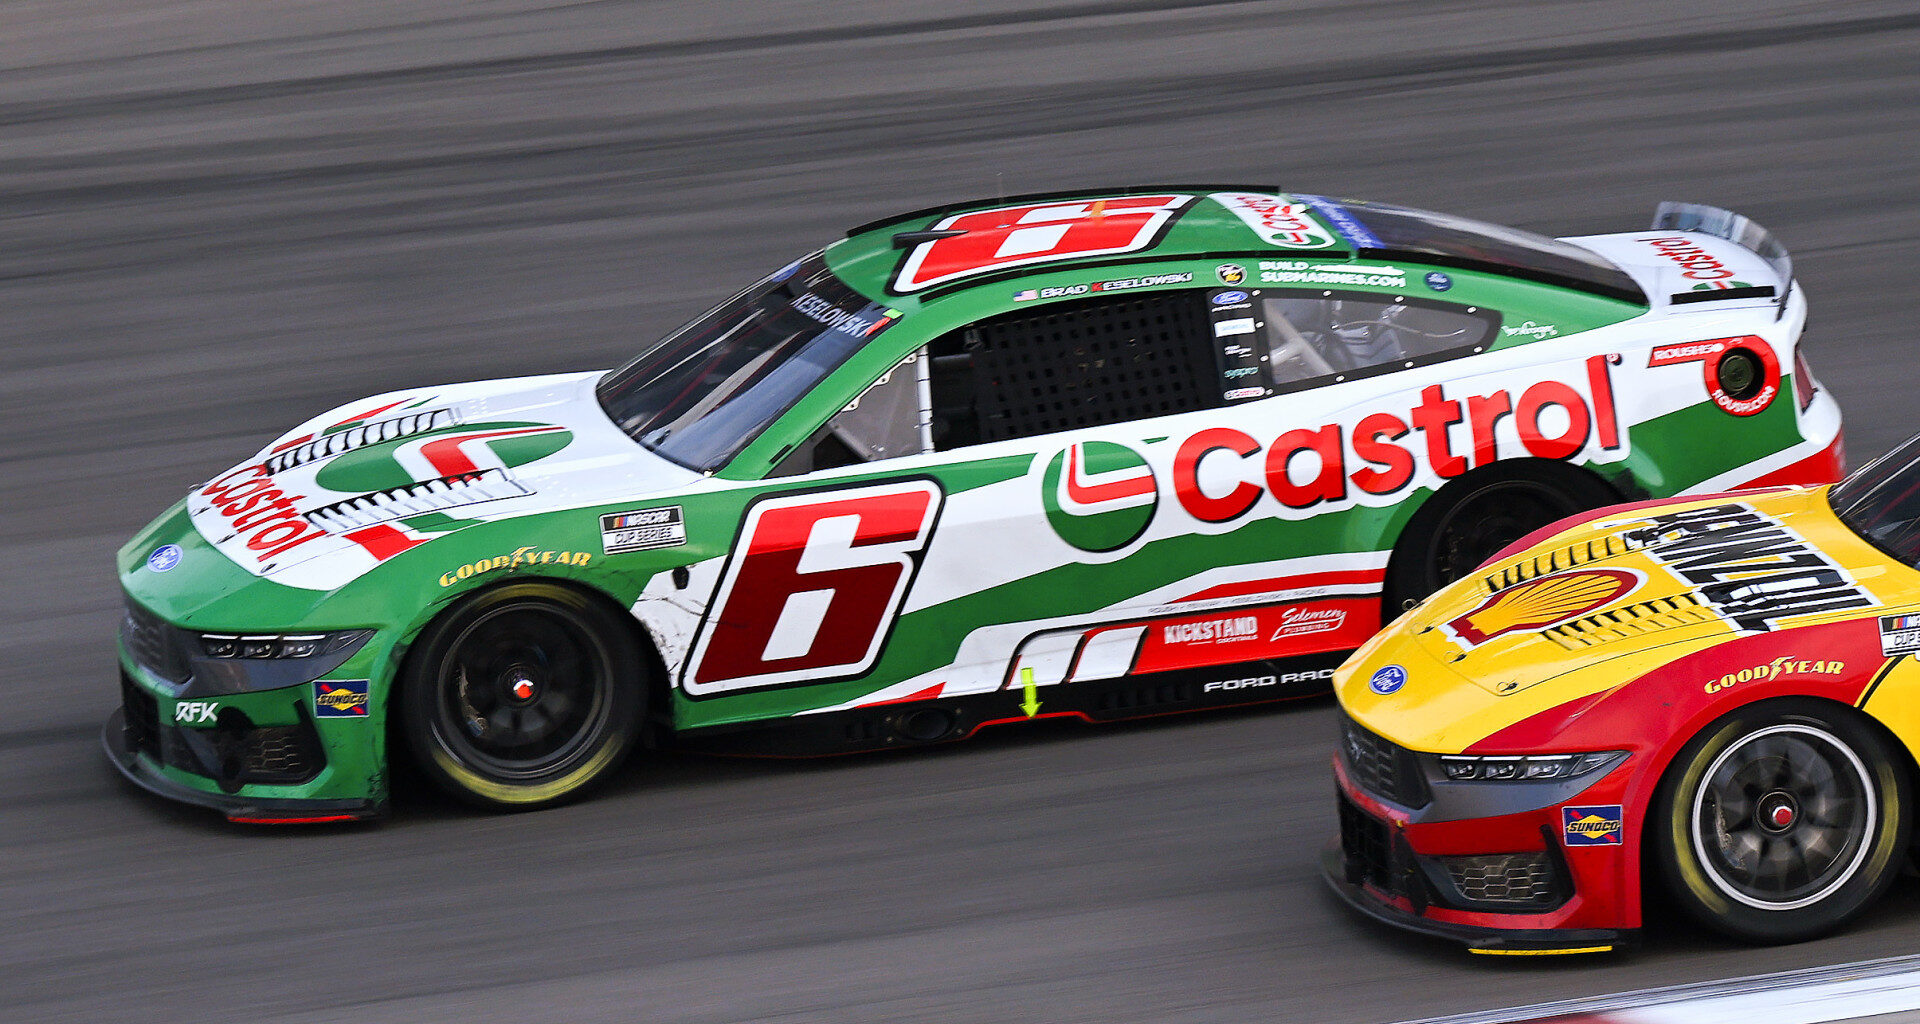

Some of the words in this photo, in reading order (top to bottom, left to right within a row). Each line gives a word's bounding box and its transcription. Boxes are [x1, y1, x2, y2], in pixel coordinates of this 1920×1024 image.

[894, 195, 1196, 292] 6
[1258, 261, 1310, 271] BUILD
[1636, 237, 1735, 280] Castrol
[1040, 284, 1089, 299] BRAD
[1091, 272, 1193, 293] KESELOWSKI
[1259, 271, 1407, 288] SUBMARINES.COM
[789, 292, 873, 339] KESELOWSKI
[1173, 353, 1620, 524] Castrol
[201, 464, 330, 563] Castrol
[626, 510, 671, 527] NASCAR
[615, 531, 636, 544] CUP
[637, 527, 673, 542] SERIES
[438, 547, 592, 588] GOODYEAR
[684, 481, 940, 696] 6
[1163, 616, 1259, 645] KICKSTAND
[1203, 675, 1278, 693] FORD
[1703, 656, 1846, 694] GOODYEAR
[174, 701, 220, 723] RFK
[319, 692, 367, 706] SUNOCO
[1568, 821, 1620, 832] SUNOCO
